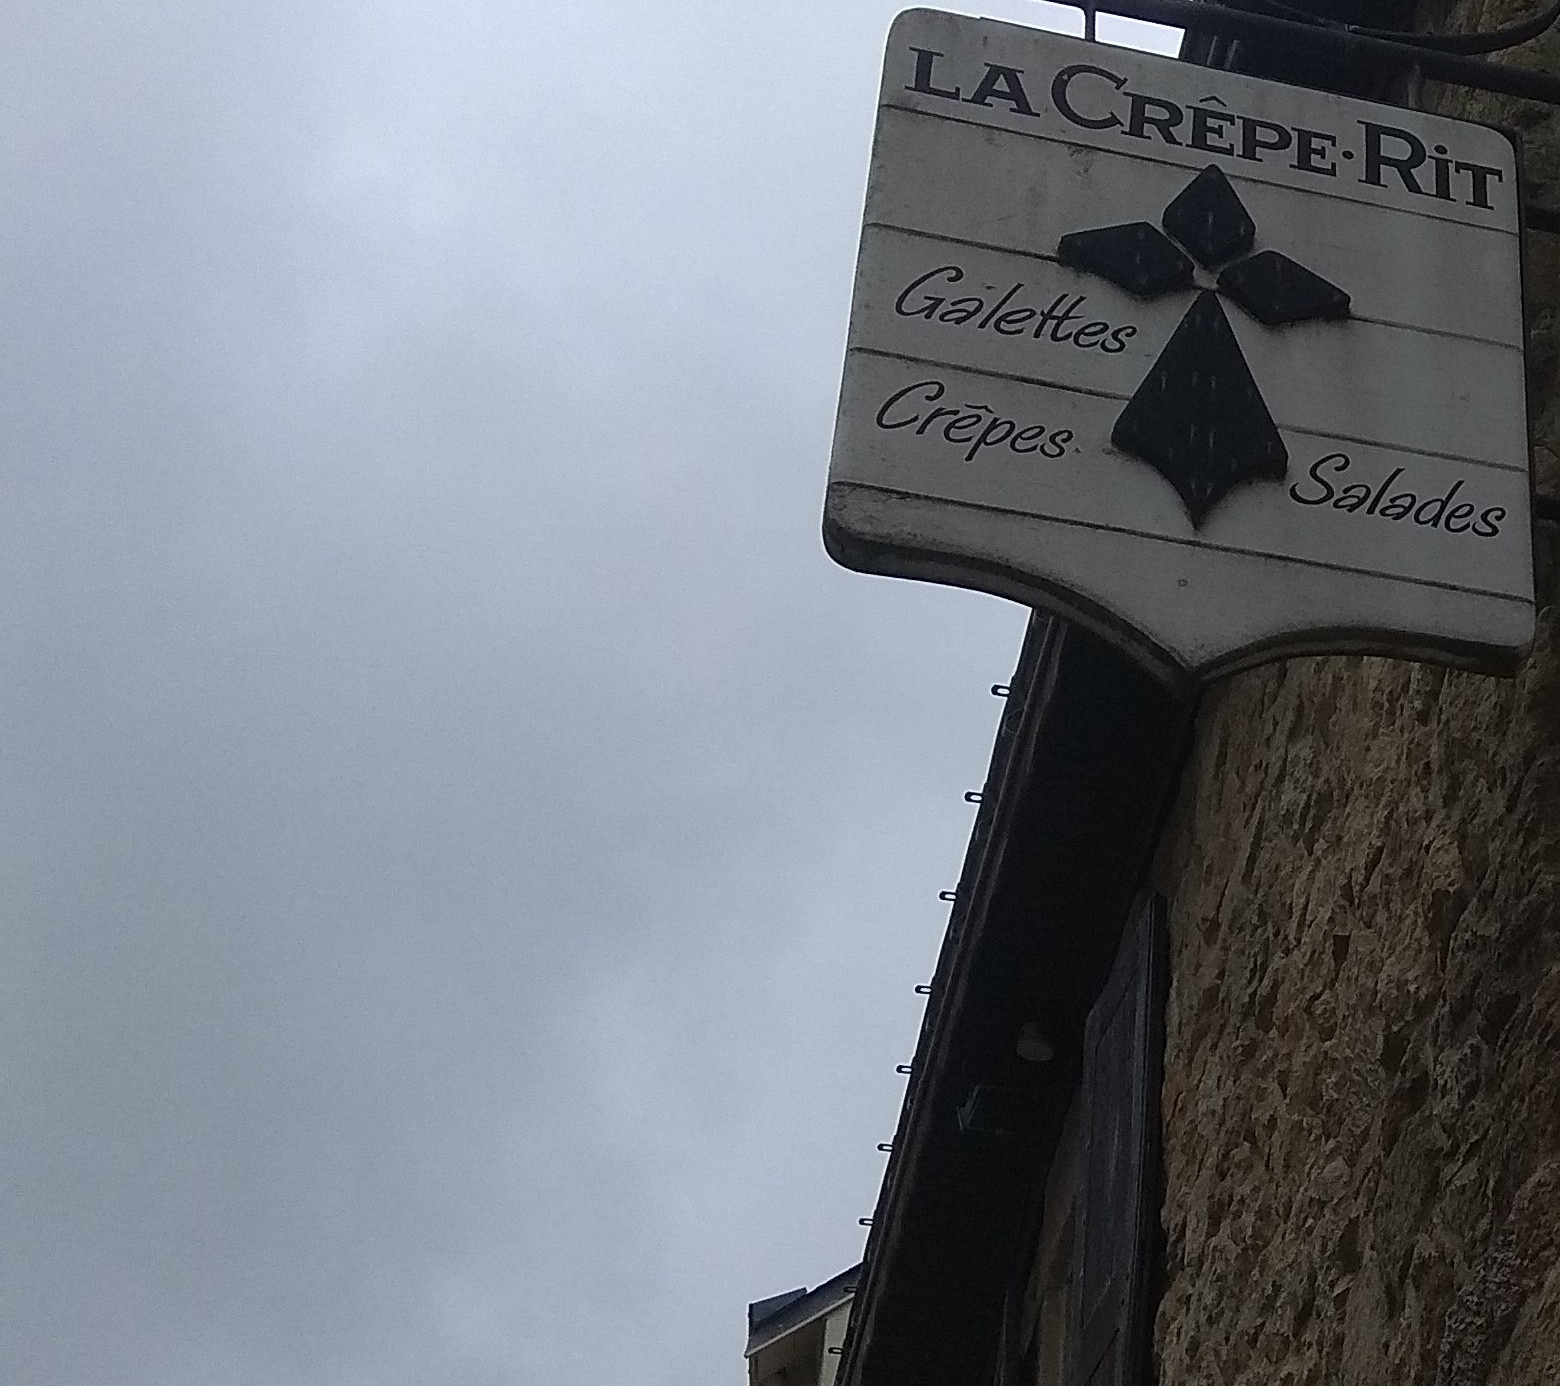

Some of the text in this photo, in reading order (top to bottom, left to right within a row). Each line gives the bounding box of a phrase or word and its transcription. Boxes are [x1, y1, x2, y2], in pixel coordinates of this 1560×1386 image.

[904, 47, 1041, 118] LA
[895, 266, 1138, 353] Galettes
[876, 380, 1074, 462] Crêpes
[1289, 453, 1506, 538] Salades
